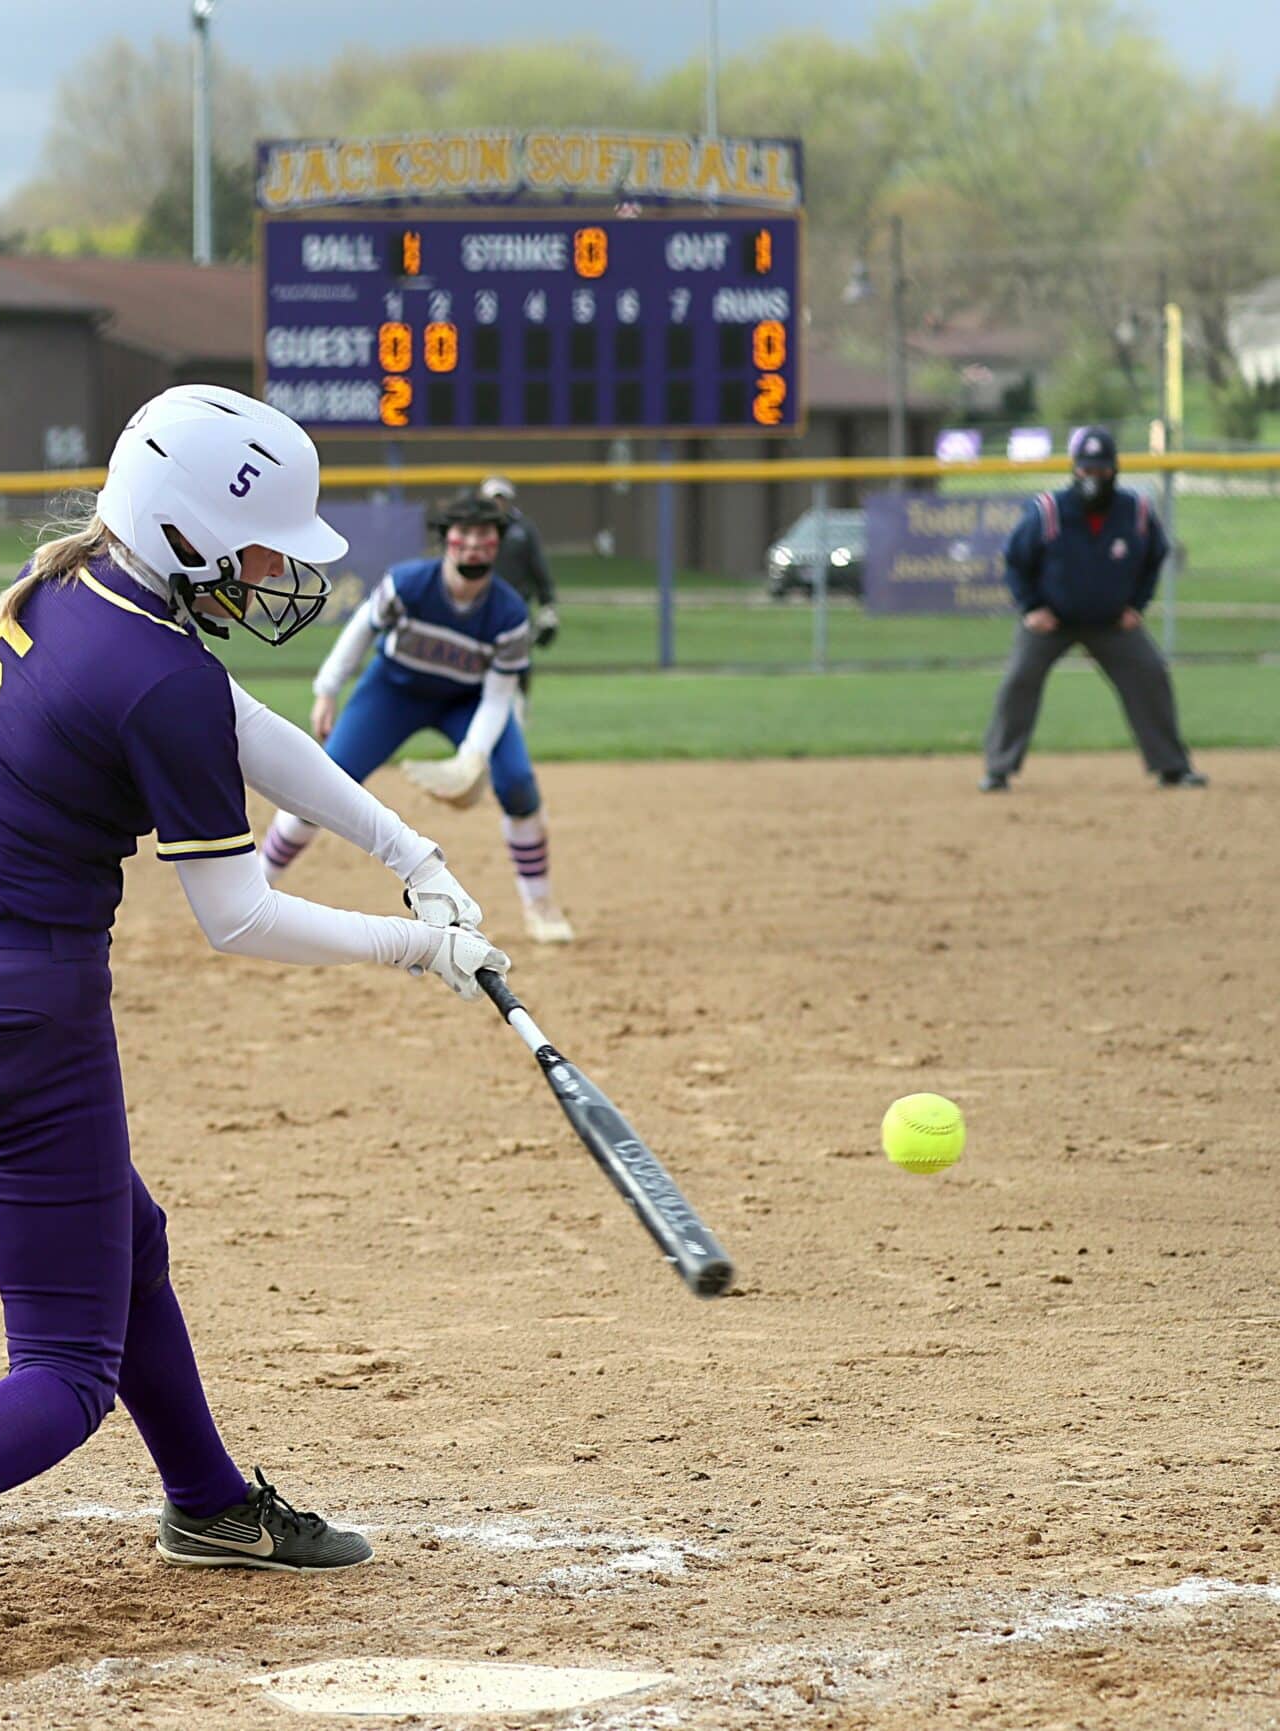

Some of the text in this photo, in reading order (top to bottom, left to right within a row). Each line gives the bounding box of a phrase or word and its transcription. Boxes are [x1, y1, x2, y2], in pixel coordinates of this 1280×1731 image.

[263, 132, 800, 207] JACKSON SOFTBALL
[301, 233, 379, 271] BALL
[461, 233, 568, 271] STRIKE
[574, 227, 608, 278] 0
[665, 232, 729, 271] OUT
[384, 290, 403, 322] 1
[428, 290, 451, 322] 2
[474, 290, 498, 325] 3
[572, 288, 596, 324] 5
[616, 288, 640, 324] 6
[671, 287, 692, 324] 7
[712, 287, 789, 323] RUNS
[266, 320, 786, 372] GUEST 0 0 0
[380, 375, 412, 426] 2
[753, 373, 786, 425] 2
[228, 463, 261, 498] 5
